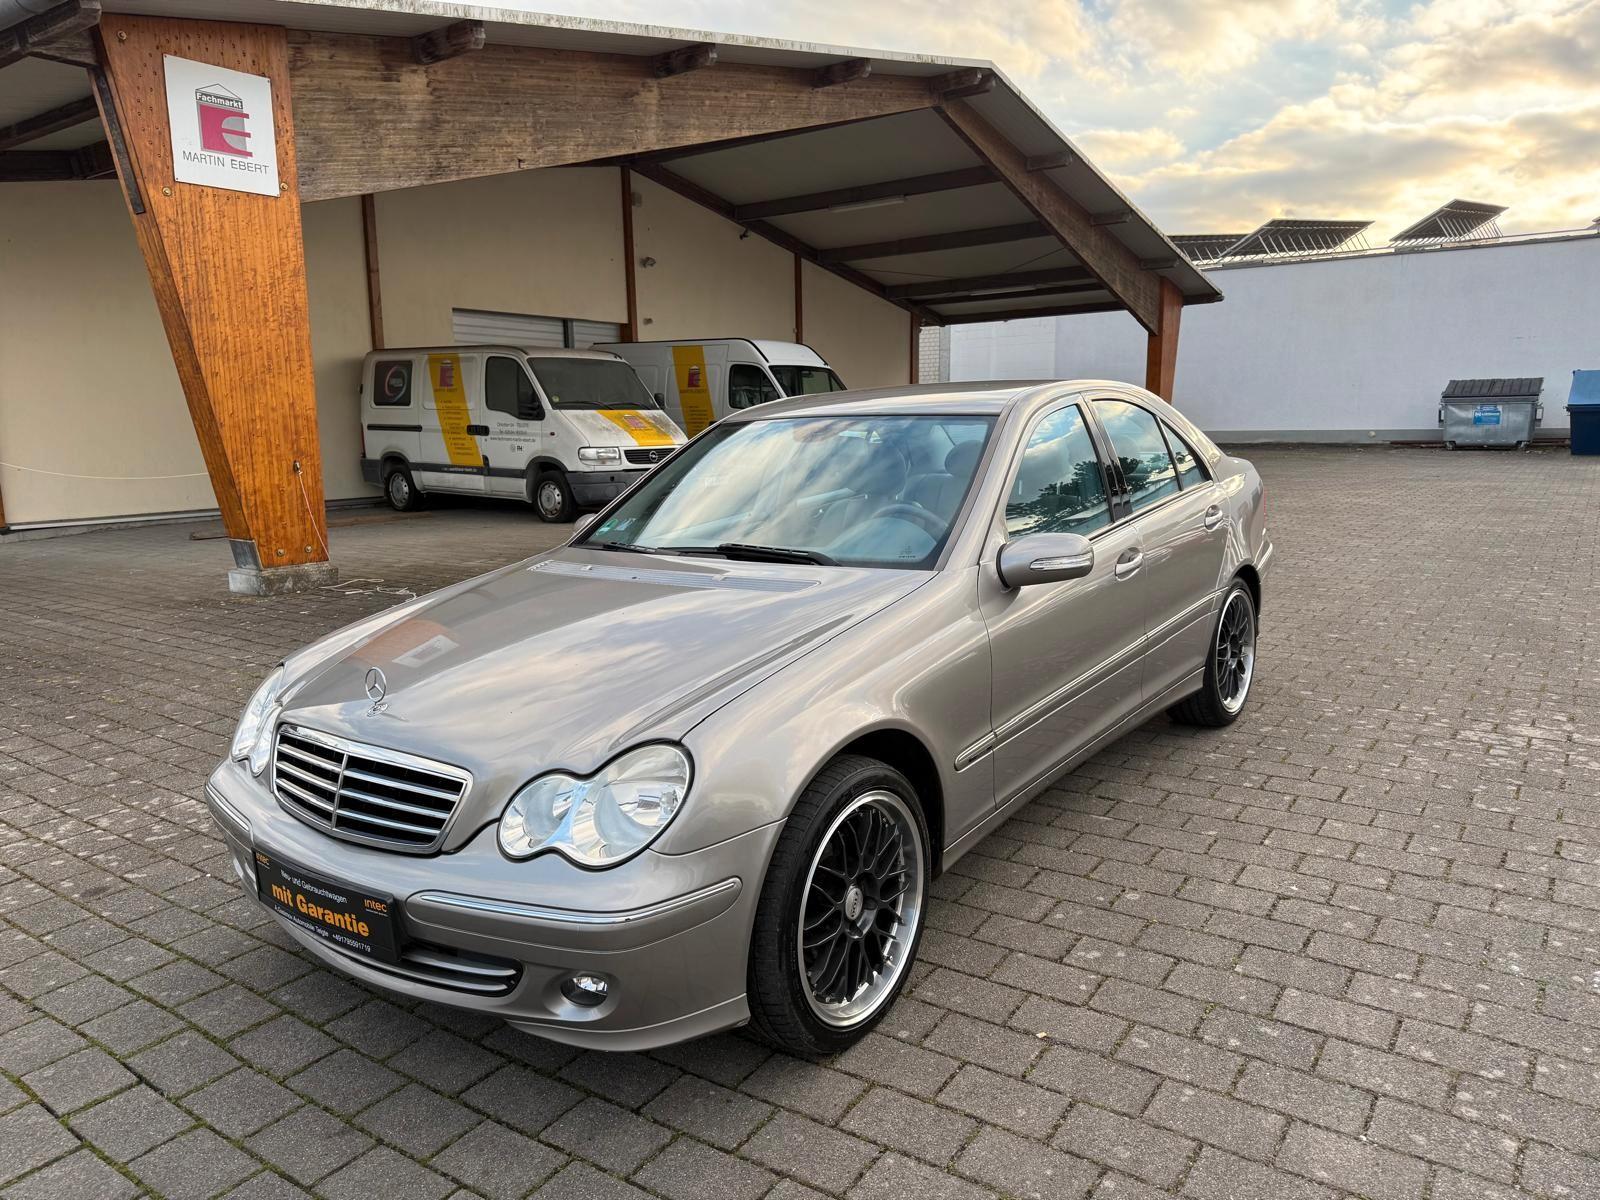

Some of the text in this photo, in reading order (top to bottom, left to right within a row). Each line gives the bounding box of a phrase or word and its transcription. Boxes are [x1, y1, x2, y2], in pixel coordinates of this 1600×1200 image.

[196, 92, 243, 109] Fachmarkt
[182, 150, 270, 175] MARTIN EBERT
[271, 883, 293, 907] mit
[296, 893, 370, 937] Garantie
[364, 899, 388, 913] intec
